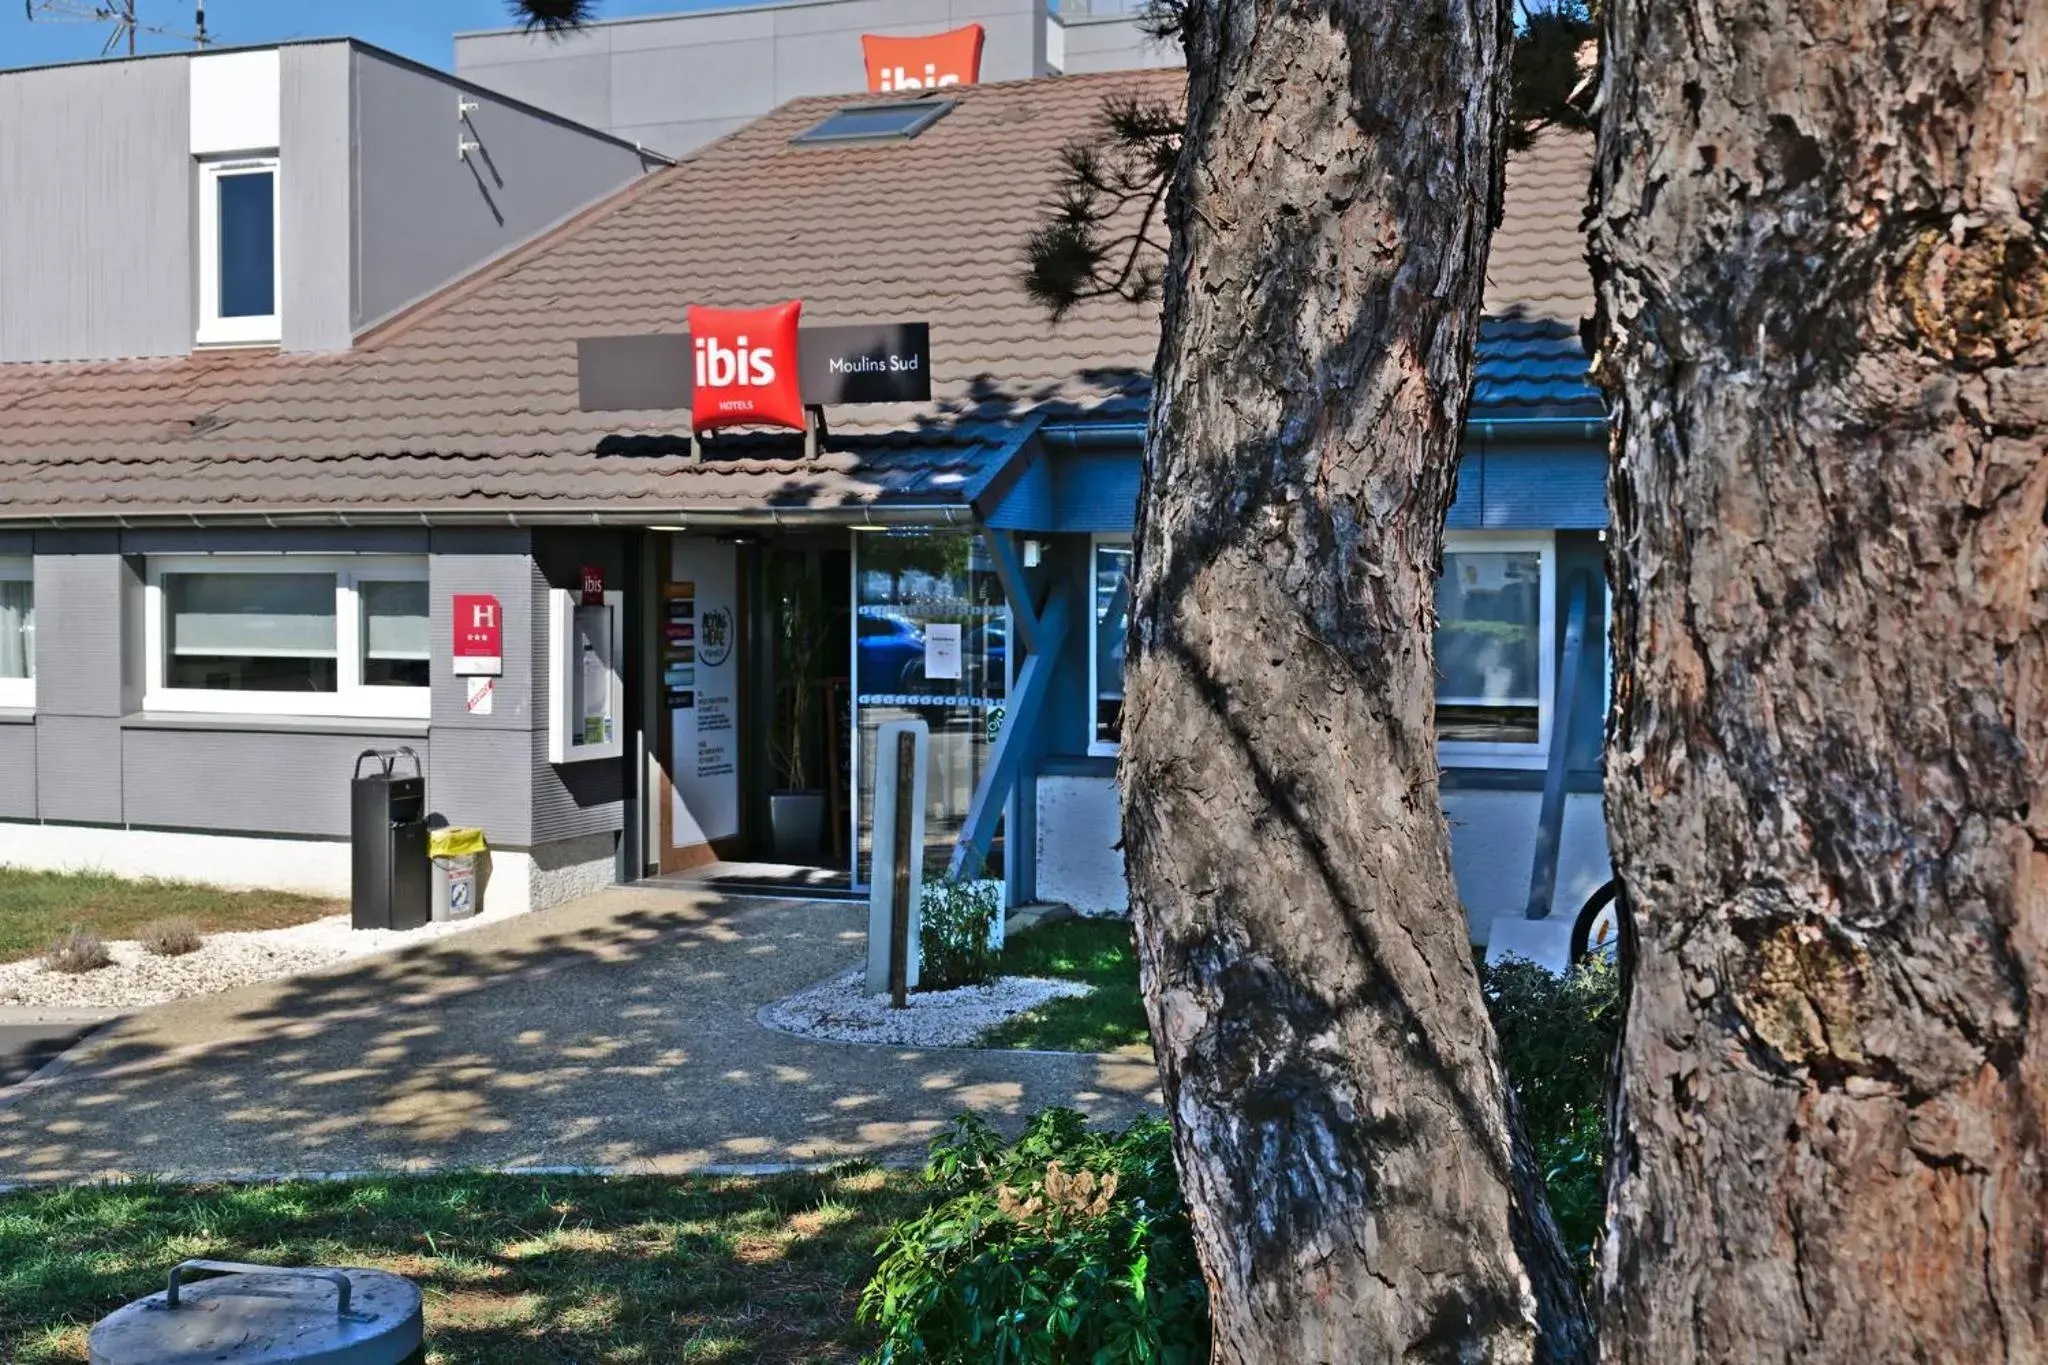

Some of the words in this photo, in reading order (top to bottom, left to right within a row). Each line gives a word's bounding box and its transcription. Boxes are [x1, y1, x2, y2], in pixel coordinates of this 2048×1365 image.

[695, 335, 776, 387] ibis
[829, 355, 886, 374] Moulins
[889, 353, 919, 372] Sud
[719, 400, 754, 411] HOTELS
[584, 575, 602, 593] ibis
[473, 604, 495, 628] H
